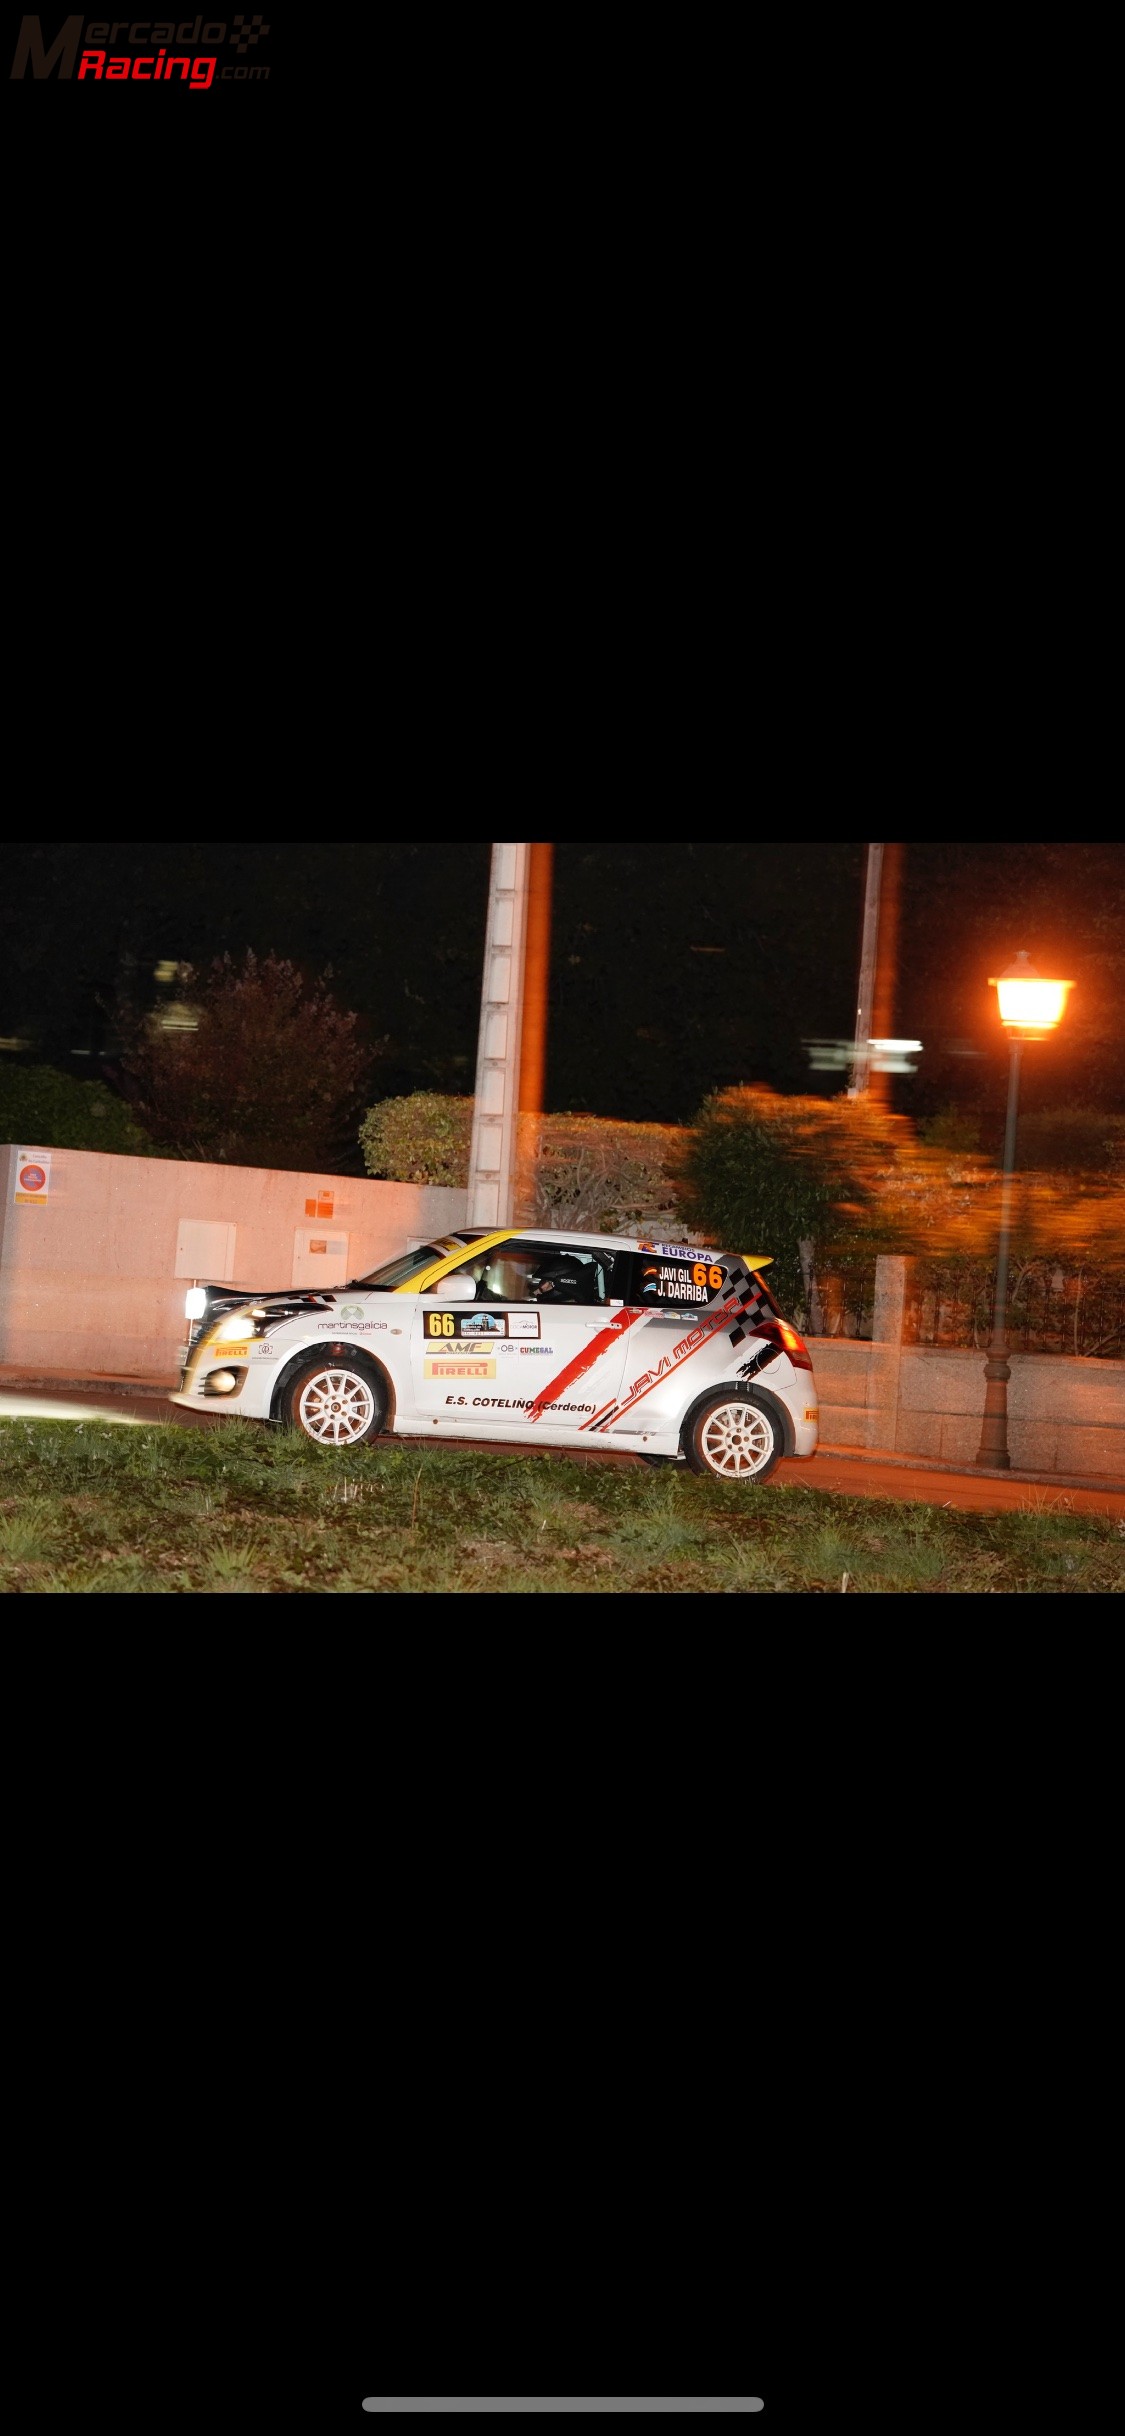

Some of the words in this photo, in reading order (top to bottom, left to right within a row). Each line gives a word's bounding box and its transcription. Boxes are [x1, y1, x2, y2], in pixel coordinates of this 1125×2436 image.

[662, 1247, 713, 1262] EUROPA
[659, 1266, 677, 1281] JAVI
[678, 1269, 692, 1283] GIL
[693, 1263, 723, 1289] 66
[658, 1281, 666, 1297] J.
[667, 1282, 708, 1302] DARRIBA
[317, 1320, 388, 1331] martinsgalicia
[429, 1313, 455, 1337] 66
[215, 1347, 248, 1357] PIRELLI
[439, 1343, 482, 1352] AMF
[621, 1356, 671, 1406] JAVI
[672, 1297, 741, 1360] MOTOR
[432, 1363, 488, 1375] PIRELLI
[445, 1395, 468, 1405] E.S.
[472, 1397, 534, 1409] COTELIÑO
[537, 1401, 596, 1414] (Cerdedo)
